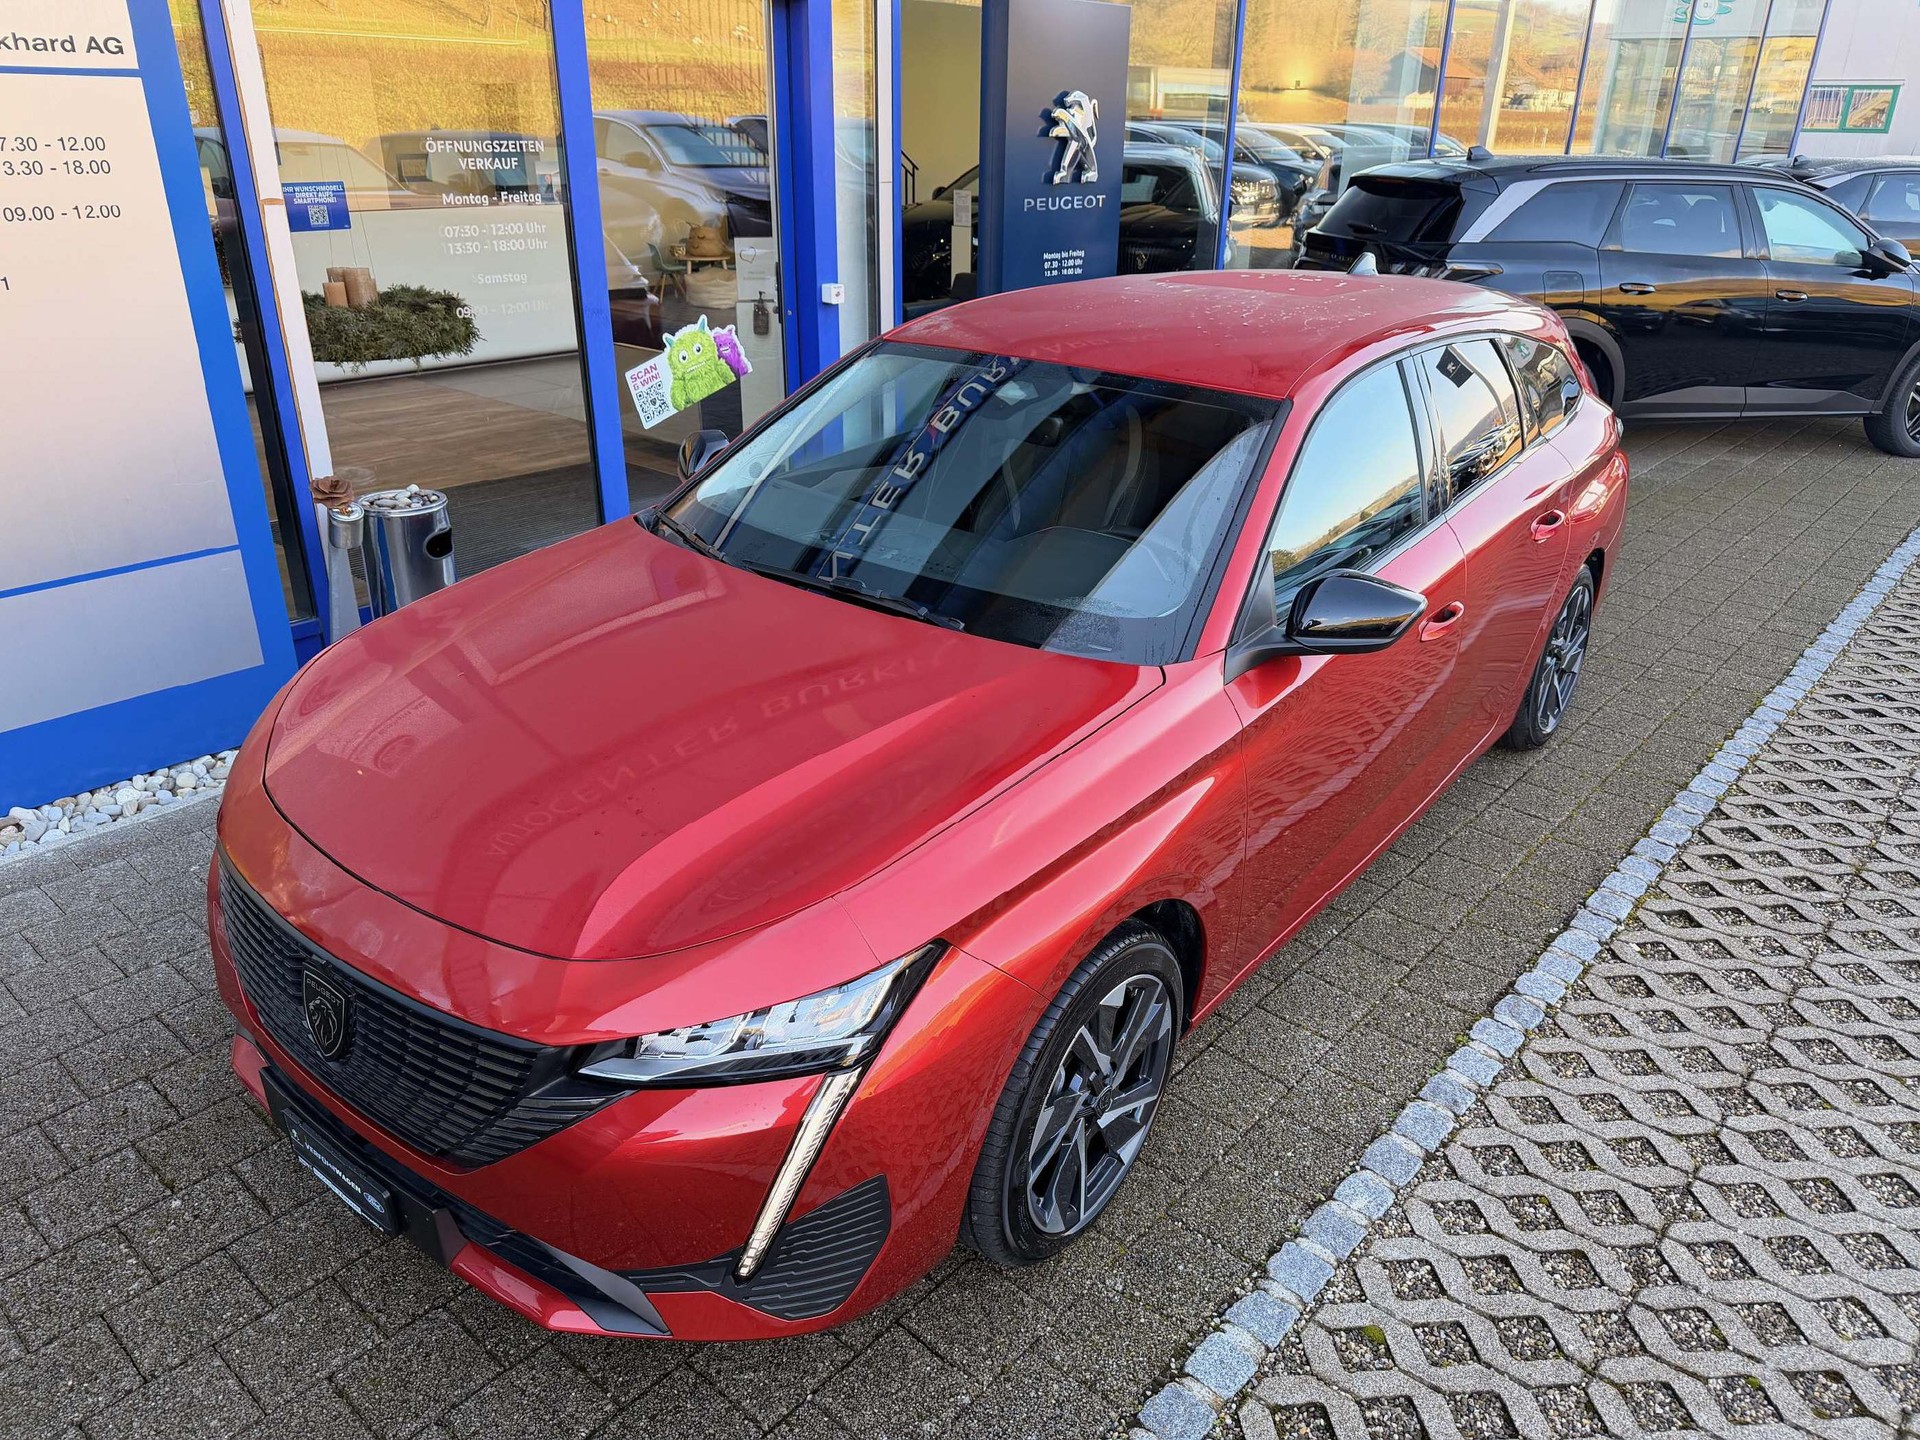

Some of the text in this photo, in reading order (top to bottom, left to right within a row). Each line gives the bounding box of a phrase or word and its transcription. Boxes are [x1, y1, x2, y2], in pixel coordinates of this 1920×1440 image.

[86, 35, 124, 55] AG
[57, 137, 106, 151] 12.00
[425, 137, 545, 153] ÖFFNUNGSZEITEN
[3, 160, 43, 175] 3.30
[63, 160, 111, 174] 18.00
[459, 158, 519, 170] VERKAUF
[441, 193, 489, 206] Montag
[501, 191, 542, 204] Freitag
[1023, 195, 1106, 211] PEUGEOT
[3, 206, 54, 222] 09.00
[72, 205, 120, 219] 12.00
[444, 225, 480, 238] 07:30
[490, 223, 524, 235] 12:00
[526, 222, 547, 233] Uhr
[447, 242, 481, 255] 13:30
[492, 240, 525, 252] 18:00
[527, 238, 549, 250] Uhr
[476, 272, 528, 284] Samstag
[630, 363, 658, 383] SCAN
[640, 372, 661, 387] WIN!
[306, 978, 341, 1006] PEUGEOT
